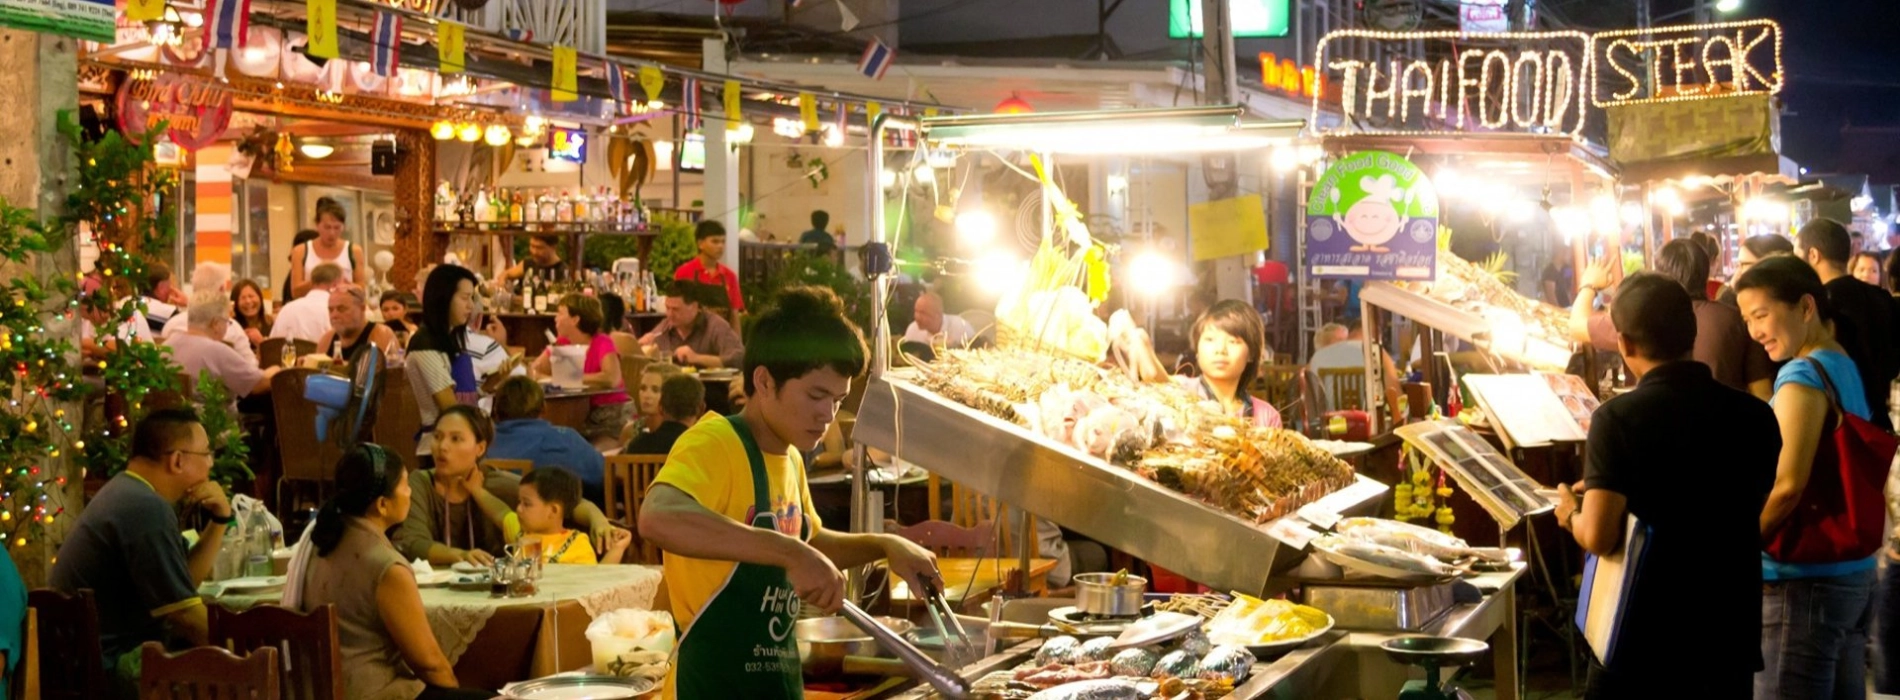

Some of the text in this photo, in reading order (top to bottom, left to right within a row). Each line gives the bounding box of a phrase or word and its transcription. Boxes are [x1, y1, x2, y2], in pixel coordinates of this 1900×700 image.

[1329, 59, 1449, 124] THAI
[1456, 49, 1572, 129] FOOD
[1606, 28, 1775, 100] STEAK
[1312, 154, 1414, 212] Clean Food Good
